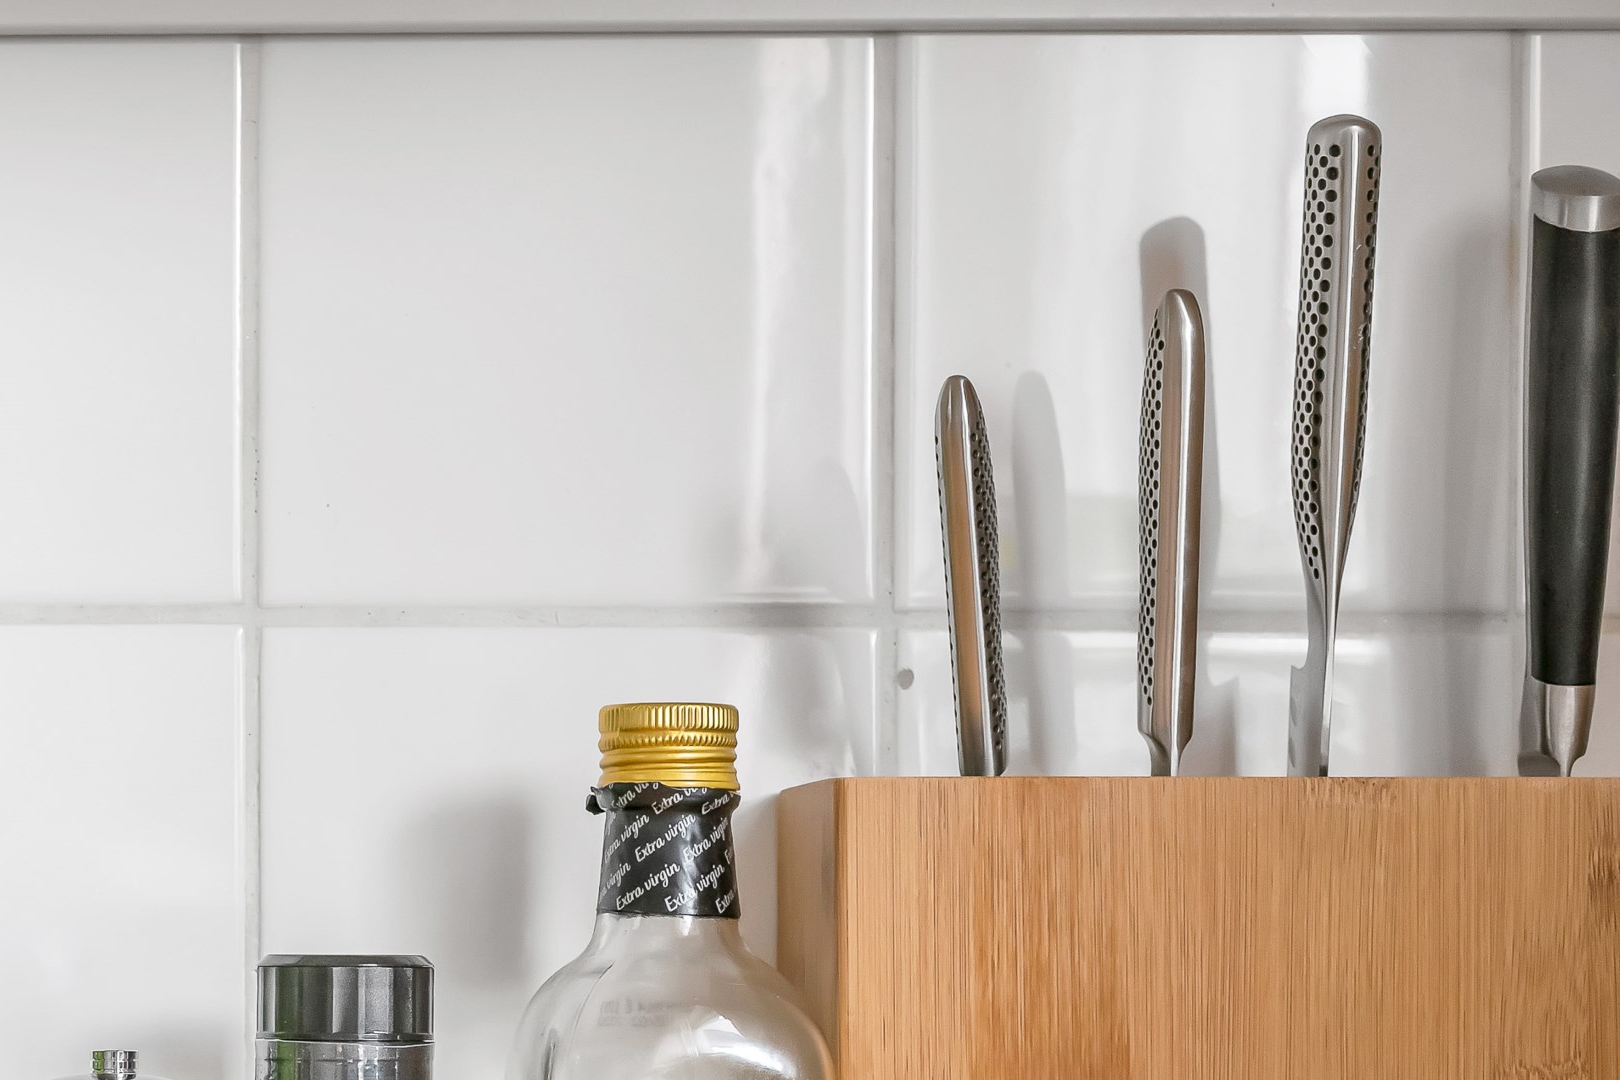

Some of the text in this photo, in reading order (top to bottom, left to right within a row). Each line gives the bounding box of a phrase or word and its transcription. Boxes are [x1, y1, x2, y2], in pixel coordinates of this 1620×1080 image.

[651, 791, 684, 815] Extra
[701, 793, 730, 815] Extra
[604, 838, 621, 864] Extra
[620, 814, 649, 842] virgin
[634, 813, 696, 862] Extra virgin
[683, 838, 711, 861] Extra
[710, 816, 729, 843] virgin
[606, 862, 631, 890] virgin
[616, 885, 644, 911] Extra
[644, 862, 680, 891] virgin
[664, 864, 725, 912] Extra virgin
